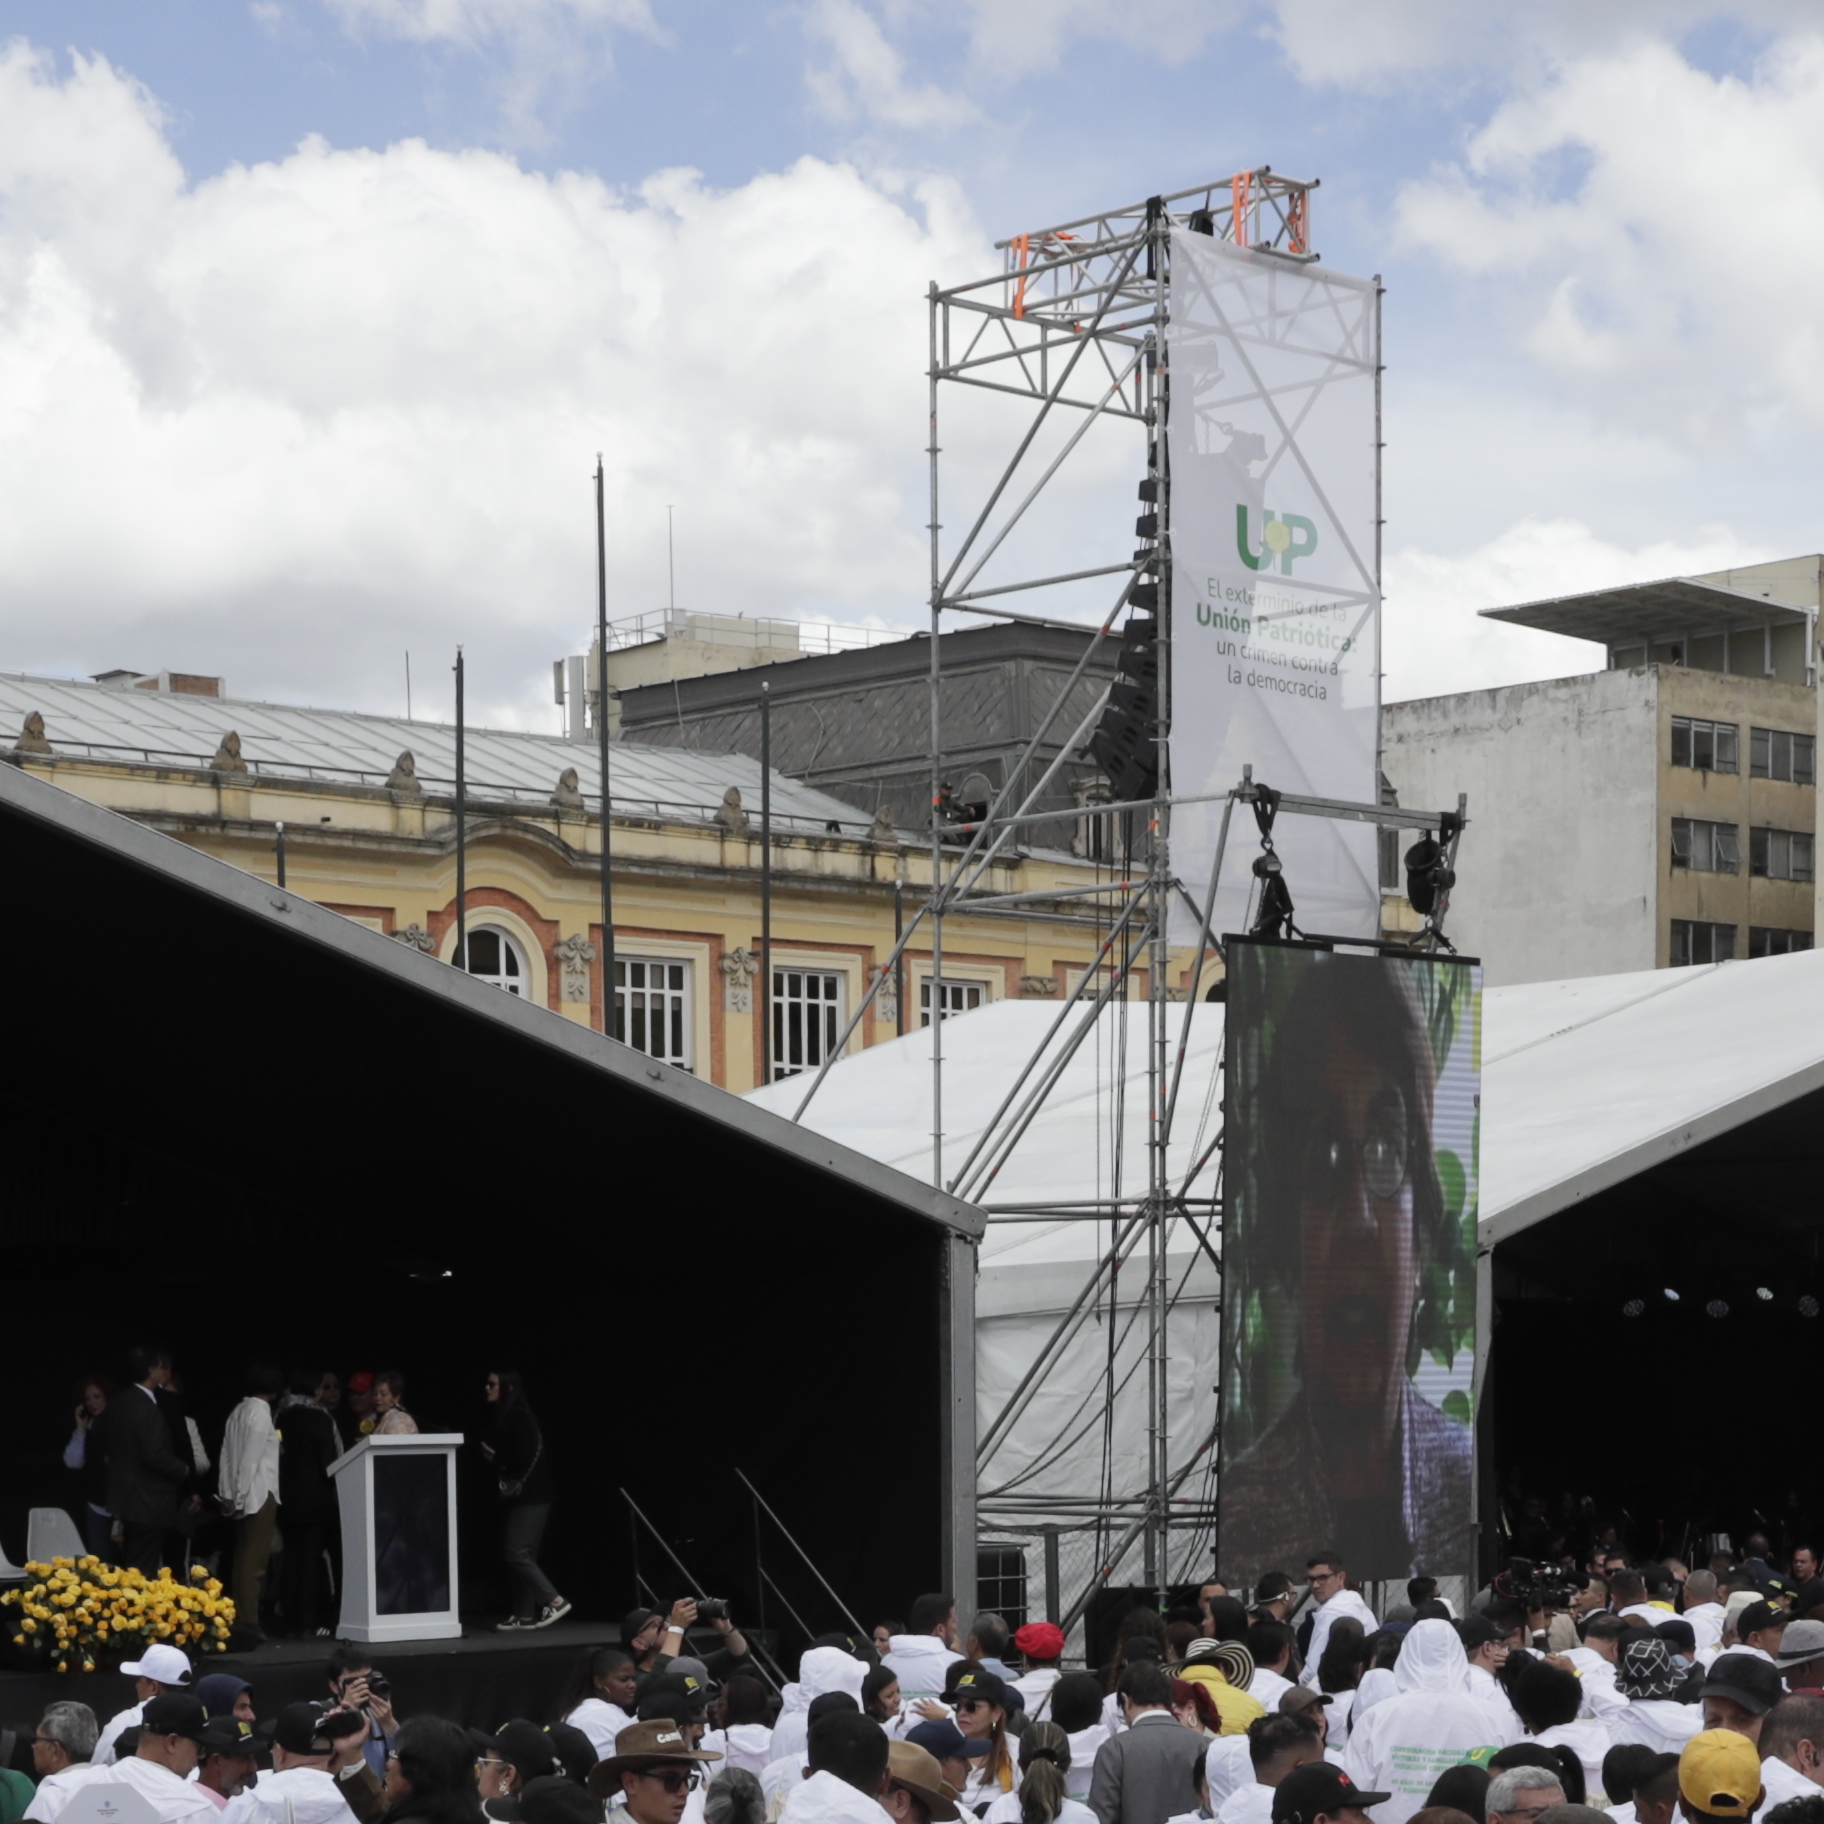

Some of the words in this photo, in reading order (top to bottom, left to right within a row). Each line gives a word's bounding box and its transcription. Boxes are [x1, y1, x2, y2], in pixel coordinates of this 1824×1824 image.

[1236, 504, 1318, 576] UP
[1208, 577, 1222, 599] El
[1226, 586, 1304, 615] exterminio
[1309, 600, 1328, 617] de
[1333, 603, 1347, 622] la
[1196, 602, 1251, 634] Unión
[1257, 616, 1358, 653] Patriótica:
[1217, 640, 1236, 656] un
[1240, 645, 1287, 668] crimen
[1292, 655, 1338, 676] contra
[1228, 664, 1242, 684] la
[1247, 669, 1327, 700] democracia
